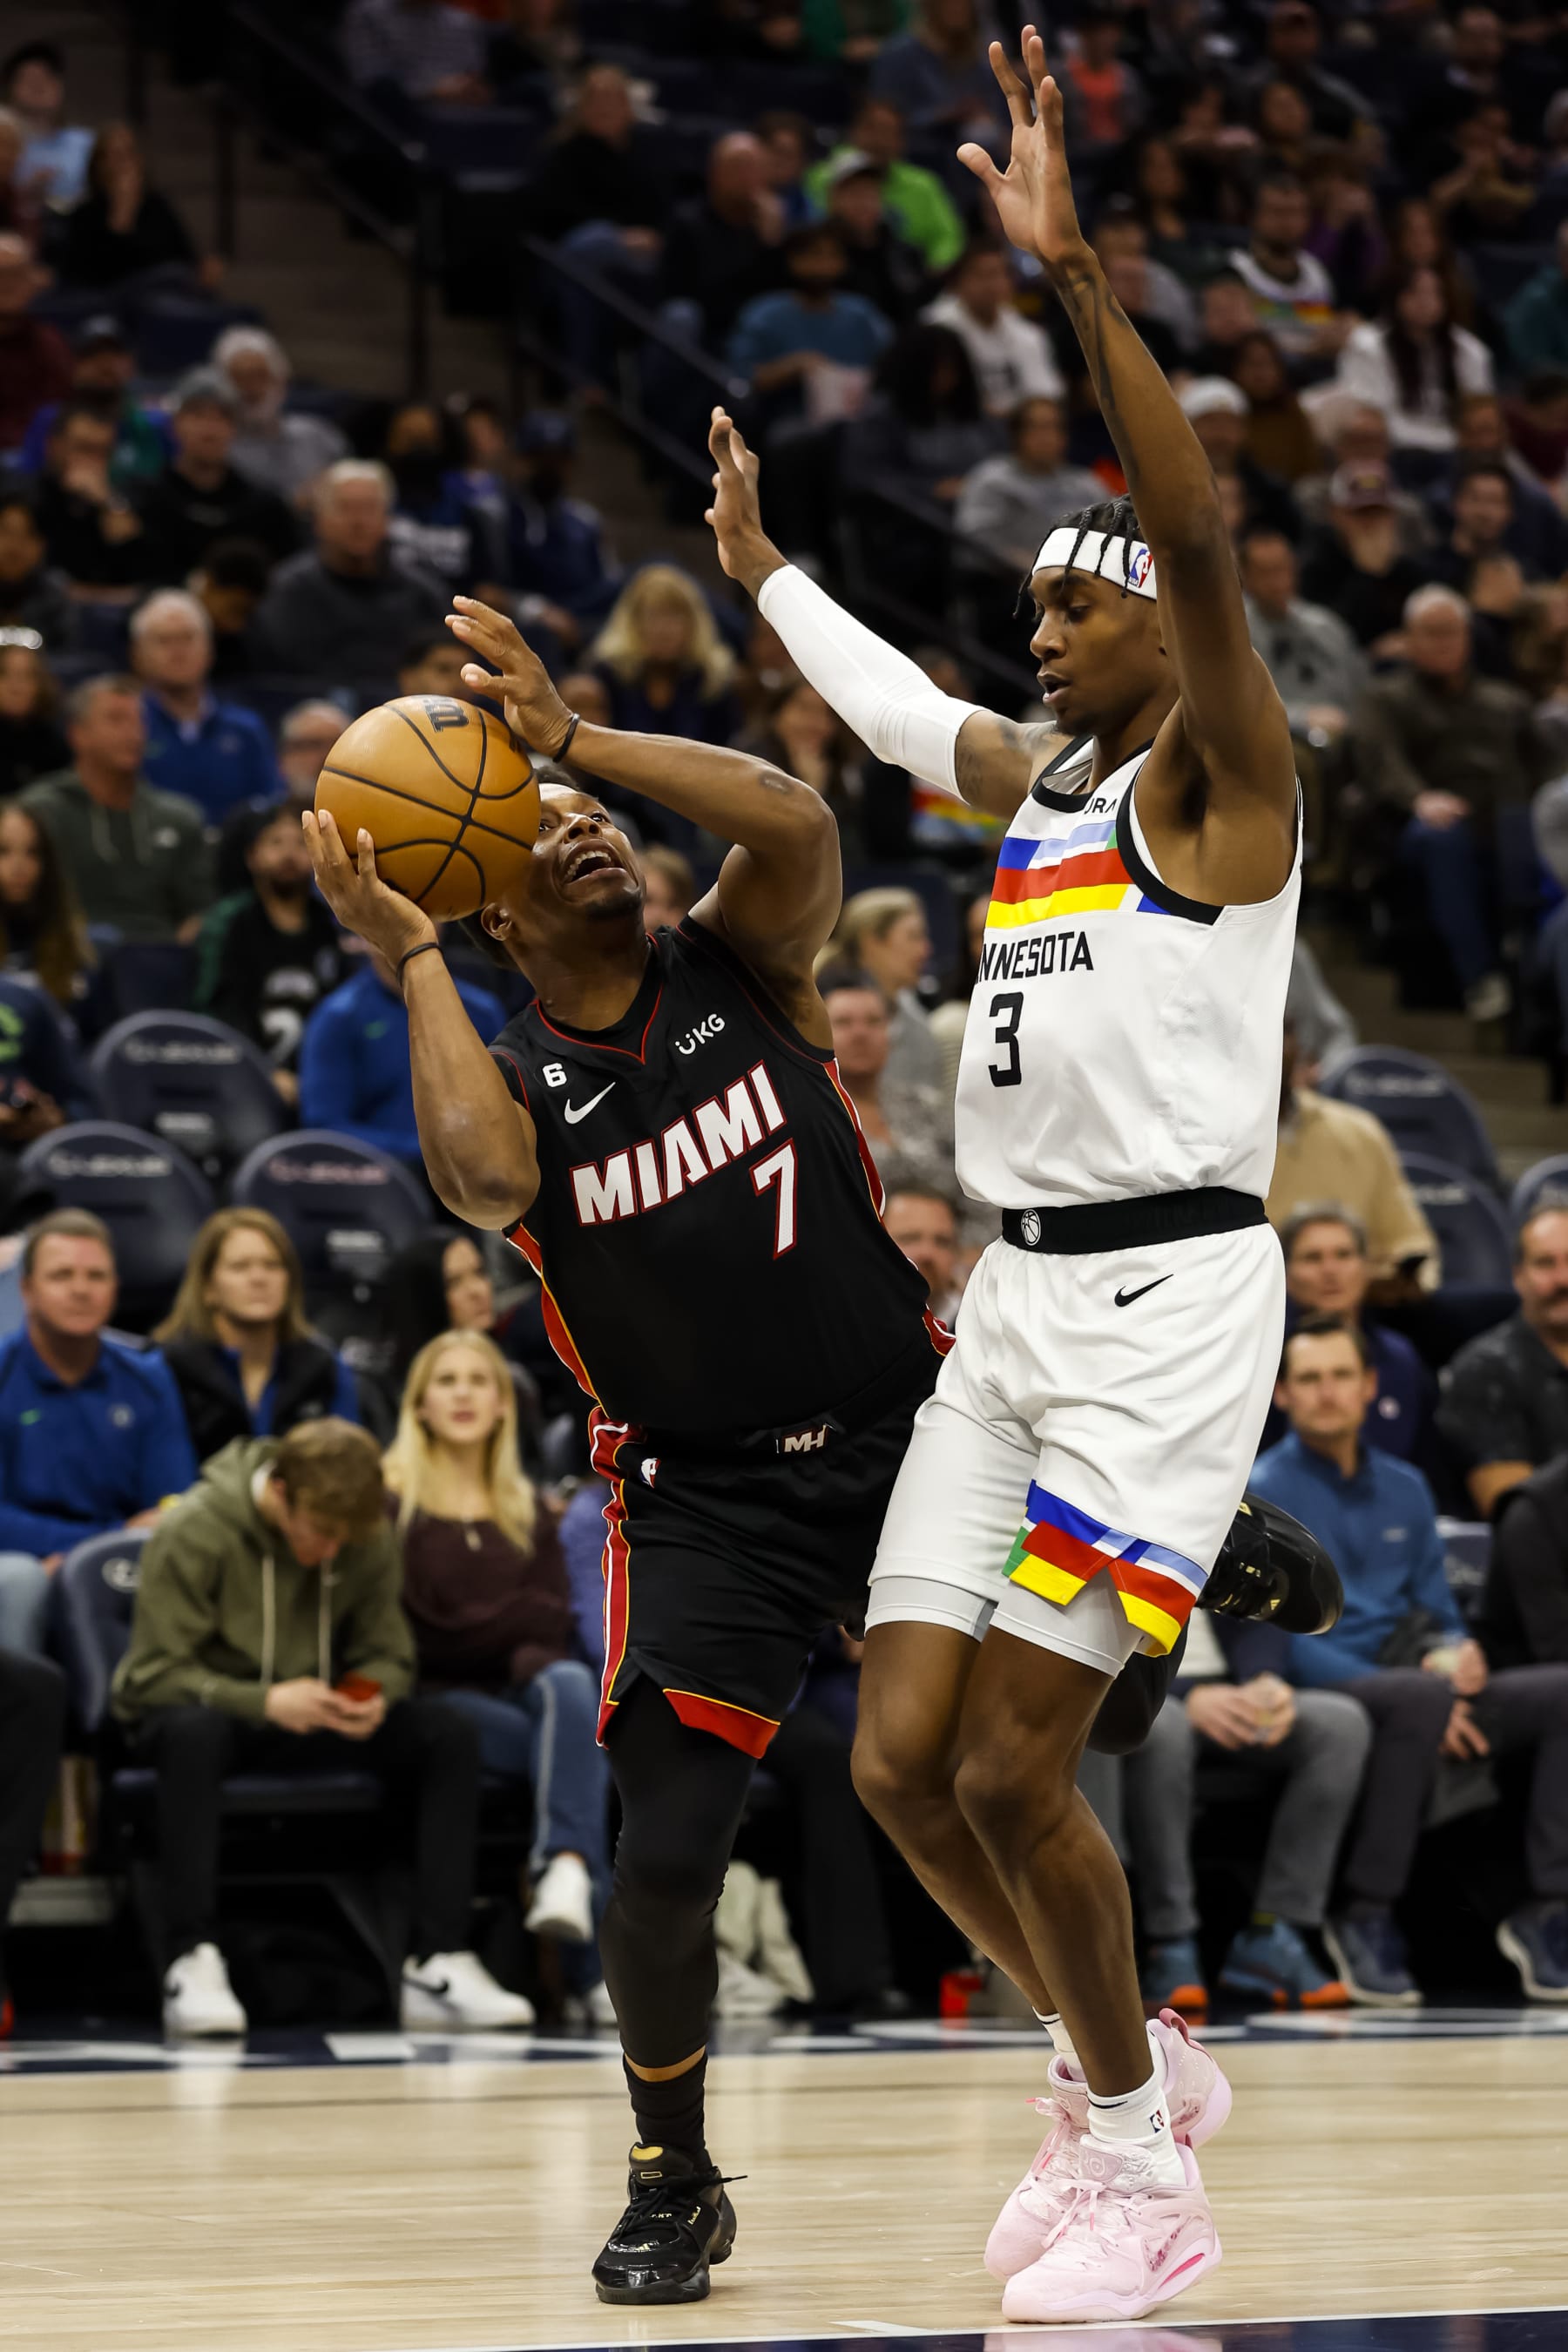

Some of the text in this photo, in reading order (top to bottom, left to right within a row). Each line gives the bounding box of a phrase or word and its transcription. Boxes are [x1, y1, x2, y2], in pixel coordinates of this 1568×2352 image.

[975, 930, 1094, 984] NNESOTA
[542, 1062, 567, 1088] 6
[988, 991, 1024, 1087] 3
[569, 1059, 787, 1227] MIAMI
[748, 1137, 797, 1260] 7
